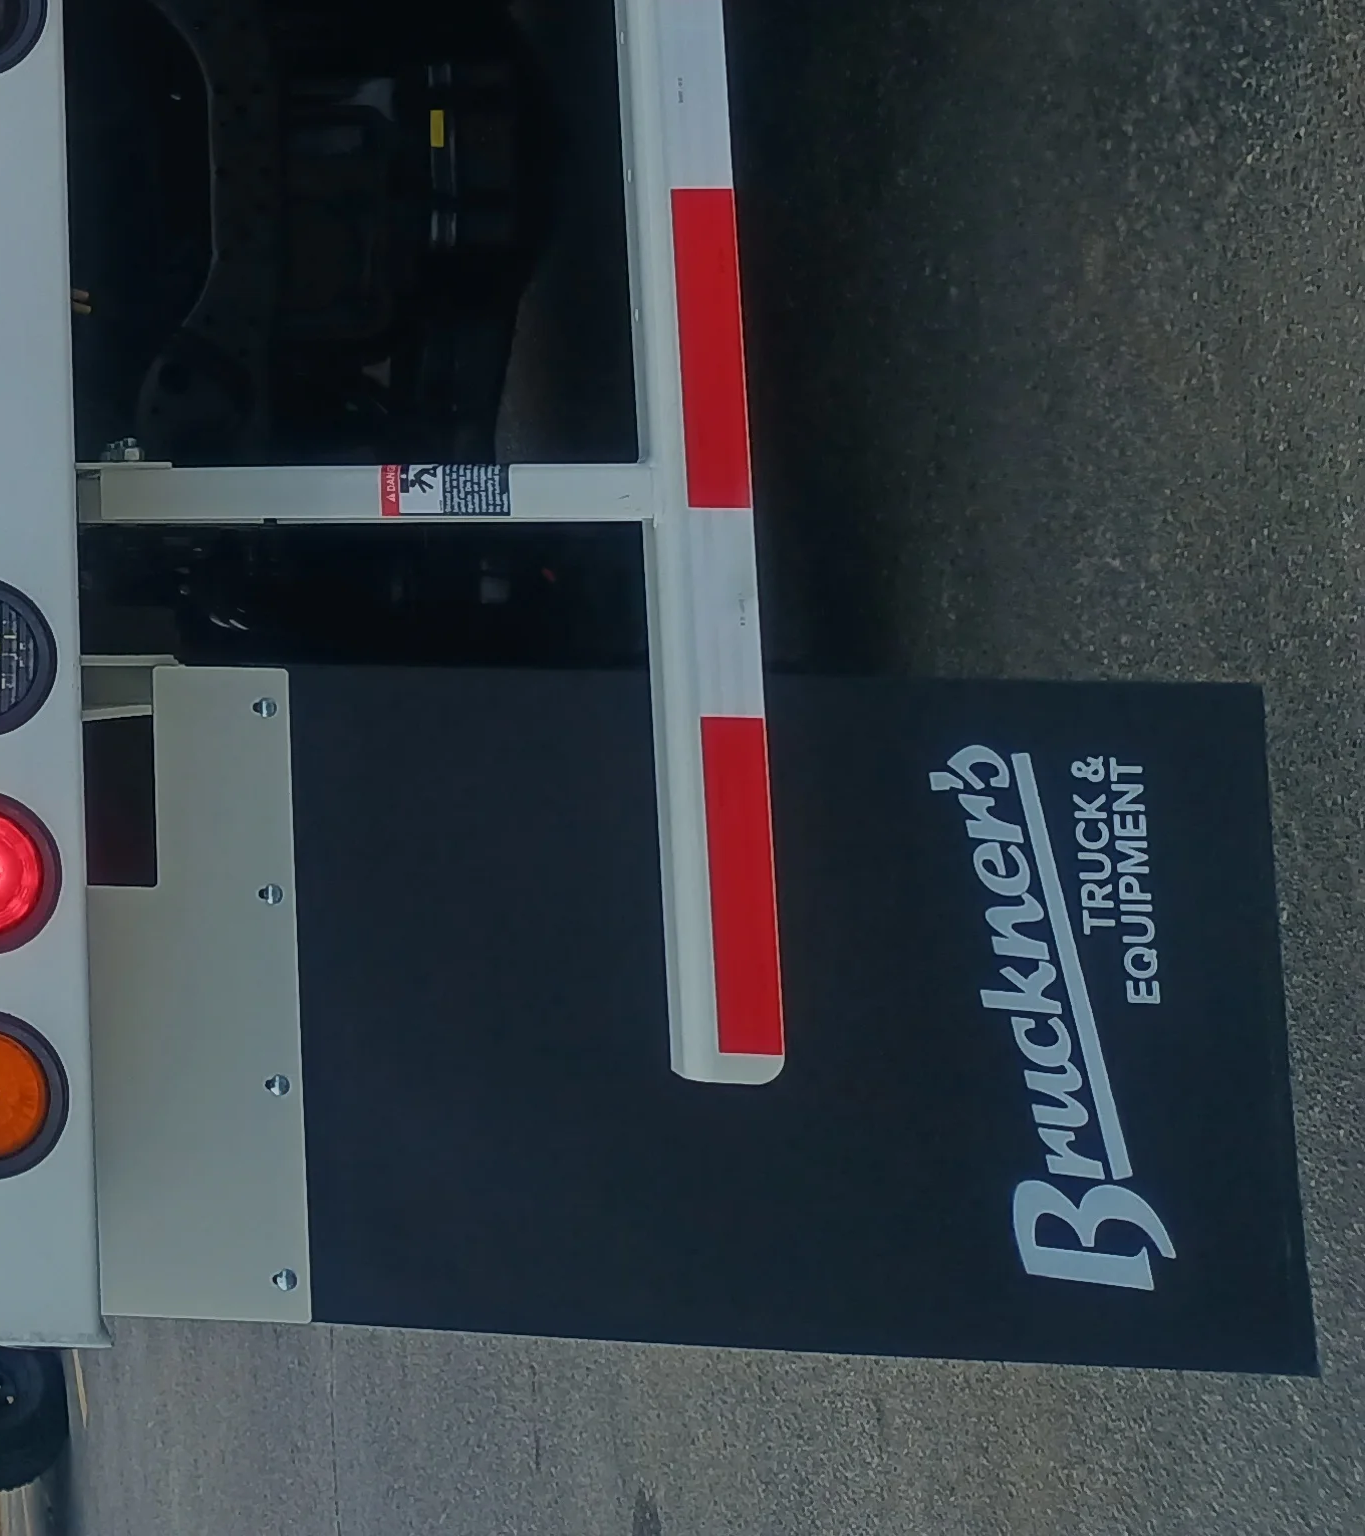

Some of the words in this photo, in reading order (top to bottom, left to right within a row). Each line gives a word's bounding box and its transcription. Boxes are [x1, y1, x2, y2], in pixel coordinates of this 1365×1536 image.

[386, 465, 396, 492] DANG
[1070, 755, 1105, 783] &
[1072, 793, 1115, 935] TRUCK
[1109, 756, 1161, 1005] EQUIPMENT
[928, 744, 1177, 1290] Bruckner's
